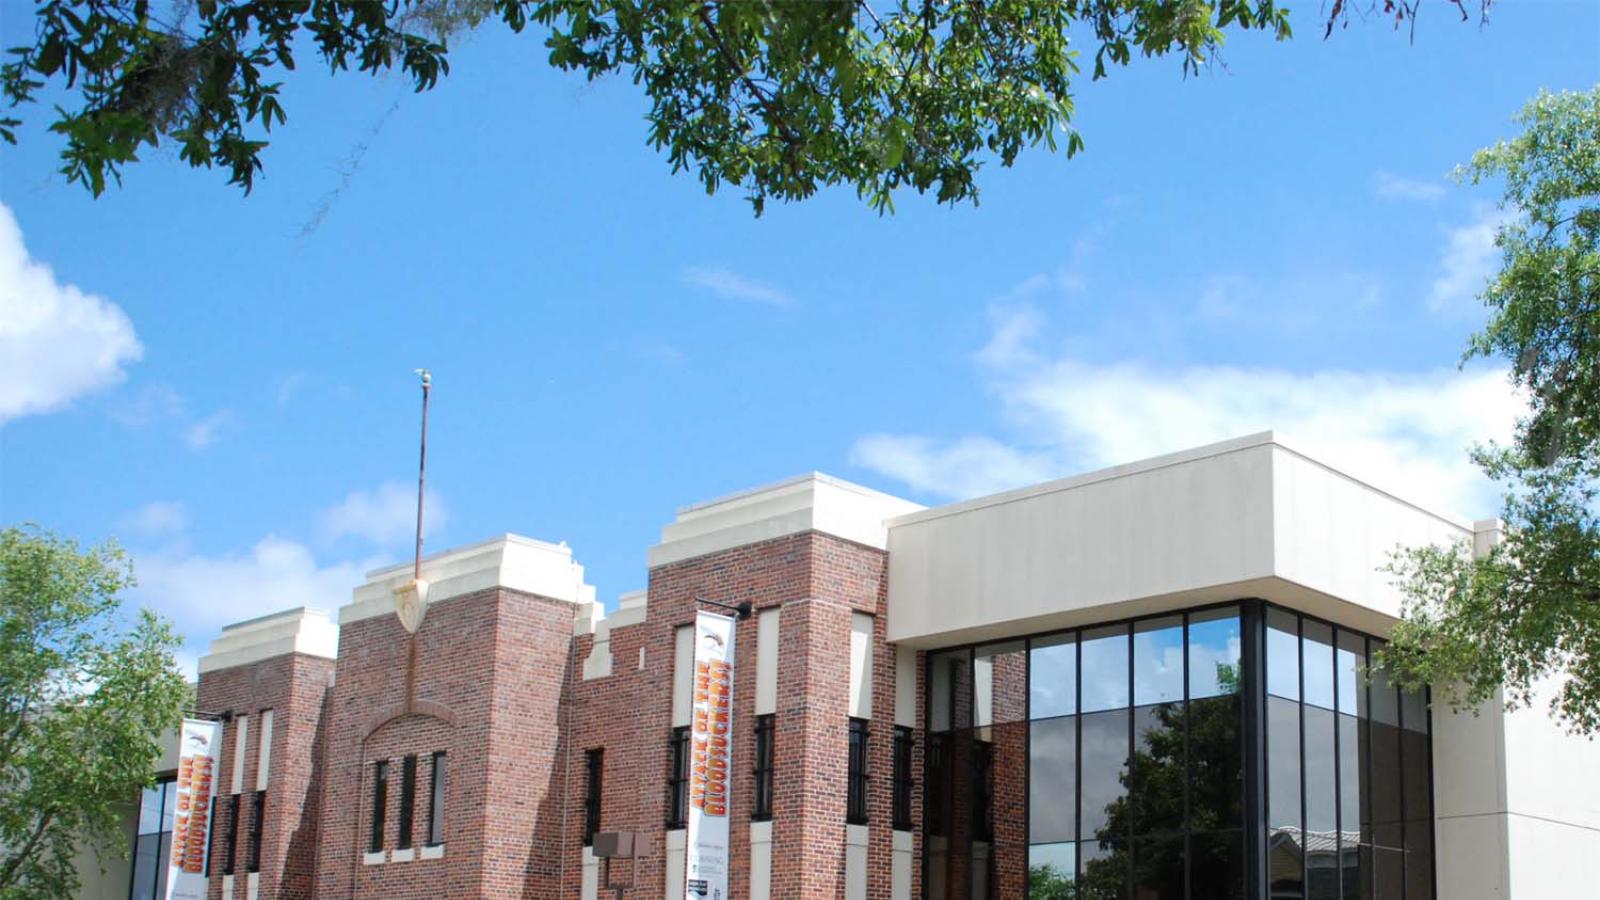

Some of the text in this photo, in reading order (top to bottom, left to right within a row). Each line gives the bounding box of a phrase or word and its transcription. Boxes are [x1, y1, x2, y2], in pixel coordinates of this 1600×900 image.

[691, 661, 709, 808] ATTACK OF THE
[179, 757, 193, 788] THE
[172, 814, 188, 867] ATTACK
